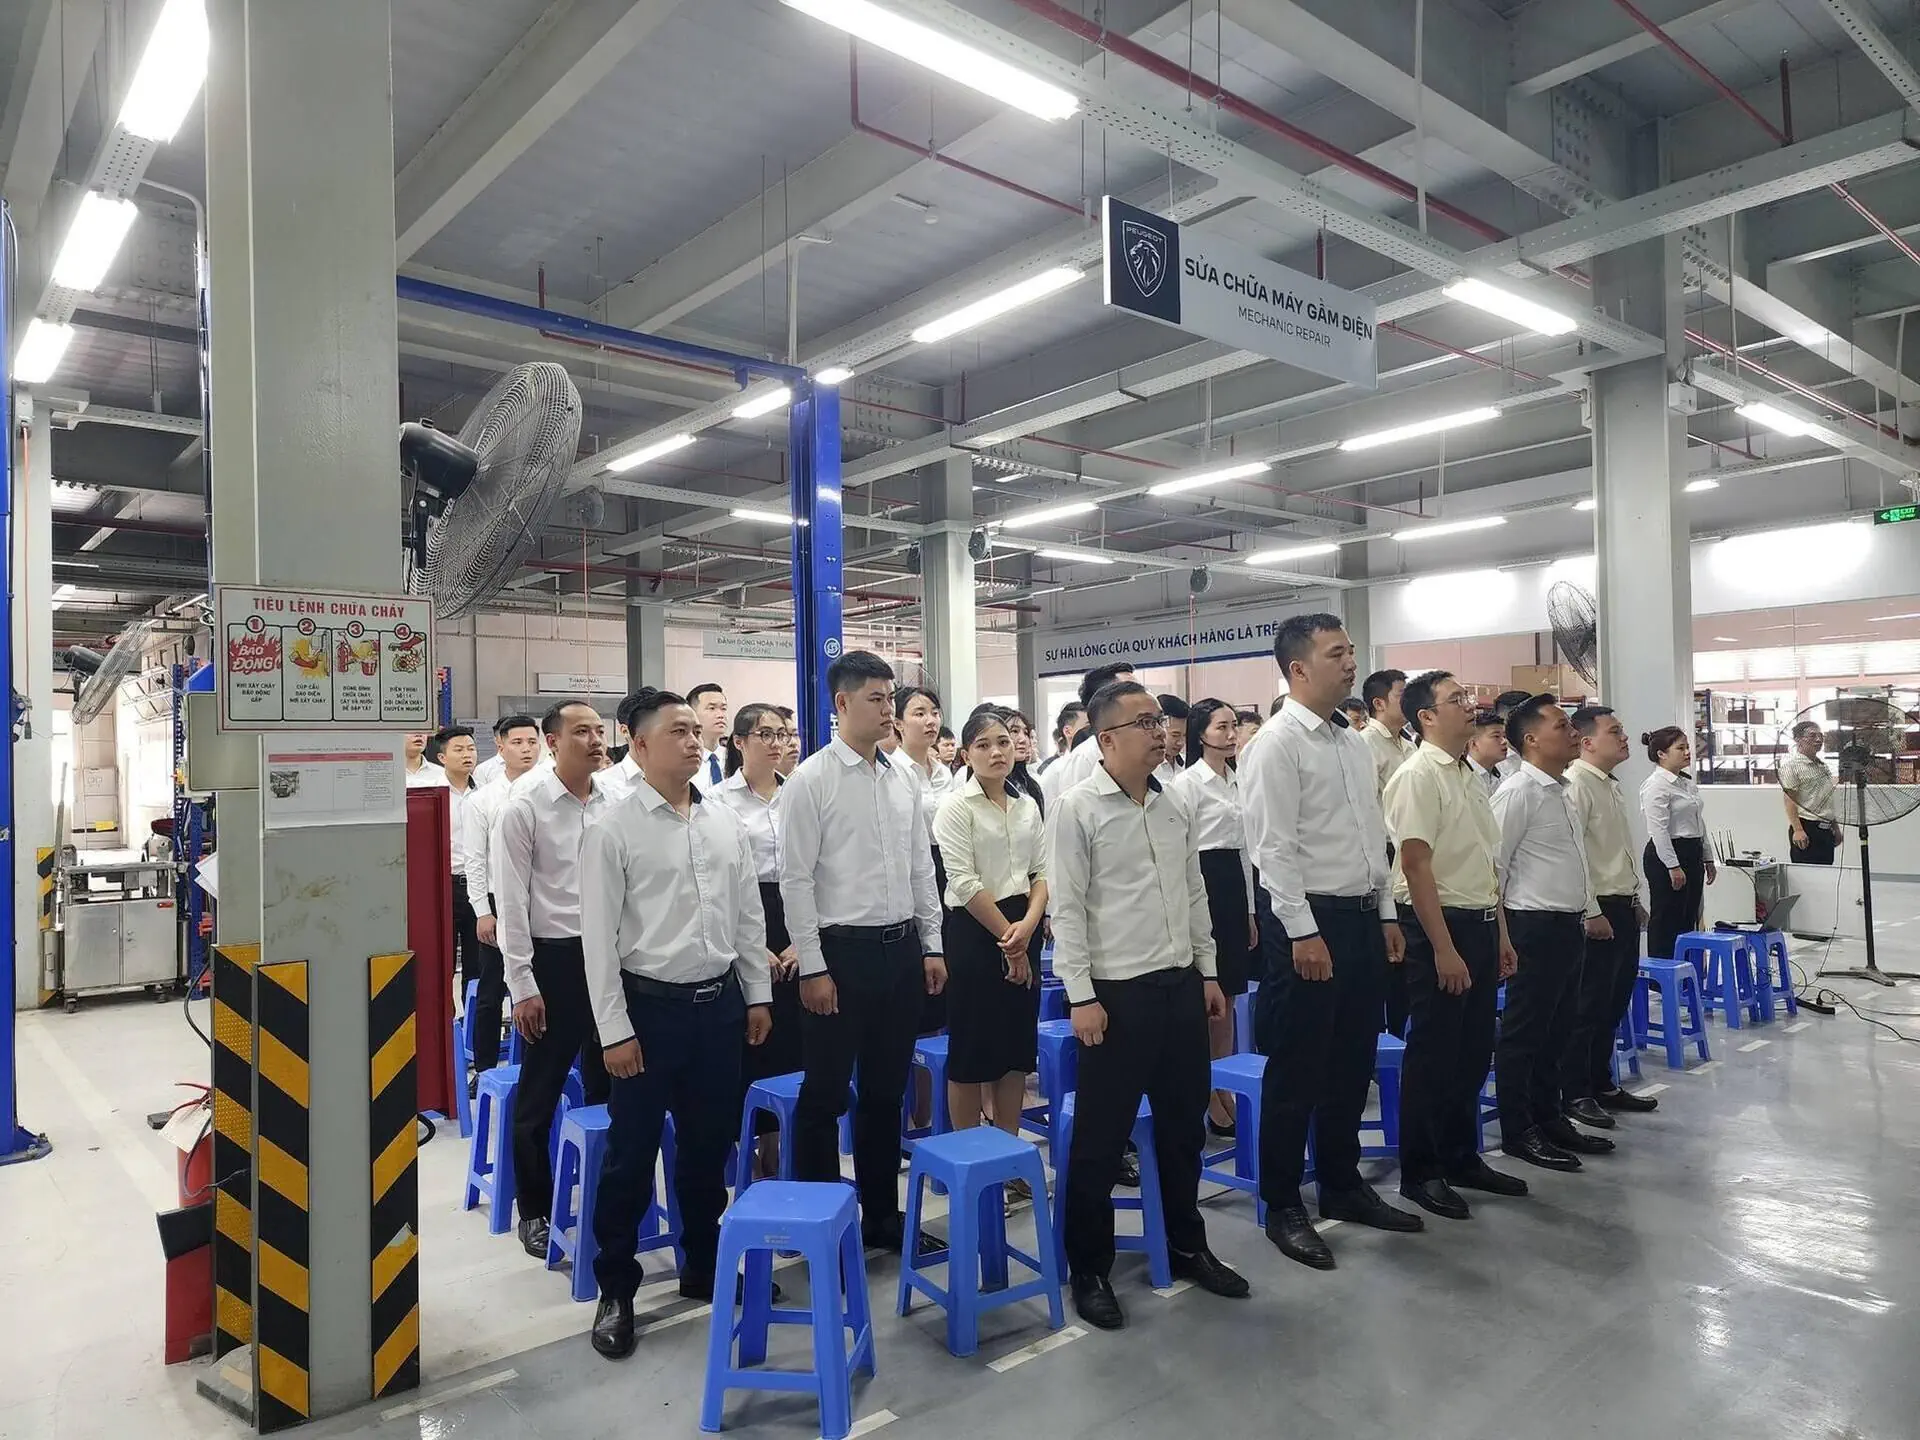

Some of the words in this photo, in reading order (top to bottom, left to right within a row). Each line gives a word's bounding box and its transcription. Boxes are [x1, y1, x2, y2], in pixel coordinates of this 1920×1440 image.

[1126, 226, 1162, 243] PEUGEOT
[1185, 254, 1219, 286] SỬA
[1223, 274, 1268, 303] CHỮA
[1272, 289, 1303, 315] MÁY
[1307, 297, 1338, 328] GẦM
[1342, 315, 1372, 341] ĐIỆN
[1238, 305, 1293, 335] MECHANIC
[1295, 325, 1330, 347] REPAIR
[253, 597, 284, 612] TIÊU
[290, 600, 325, 616] LỆNH
[331, 601, 367, 617] CHỮA
[372, 603, 404, 618] CHÁY
[250, 618, 259, 630] 1
[301, 620, 313, 632] 2
[351, 623, 361, 635] 3
[397, 625, 408, 637] 4
[1108, 639, 1130, 654] CỦA
[1158, 632, 1197, 649] KHÁCH
[1200, 628, 1234, 644] HÀNG
[1237, 624, 1253, 640] LÀ
[1255, 620, 1279, 637] TRÊ
